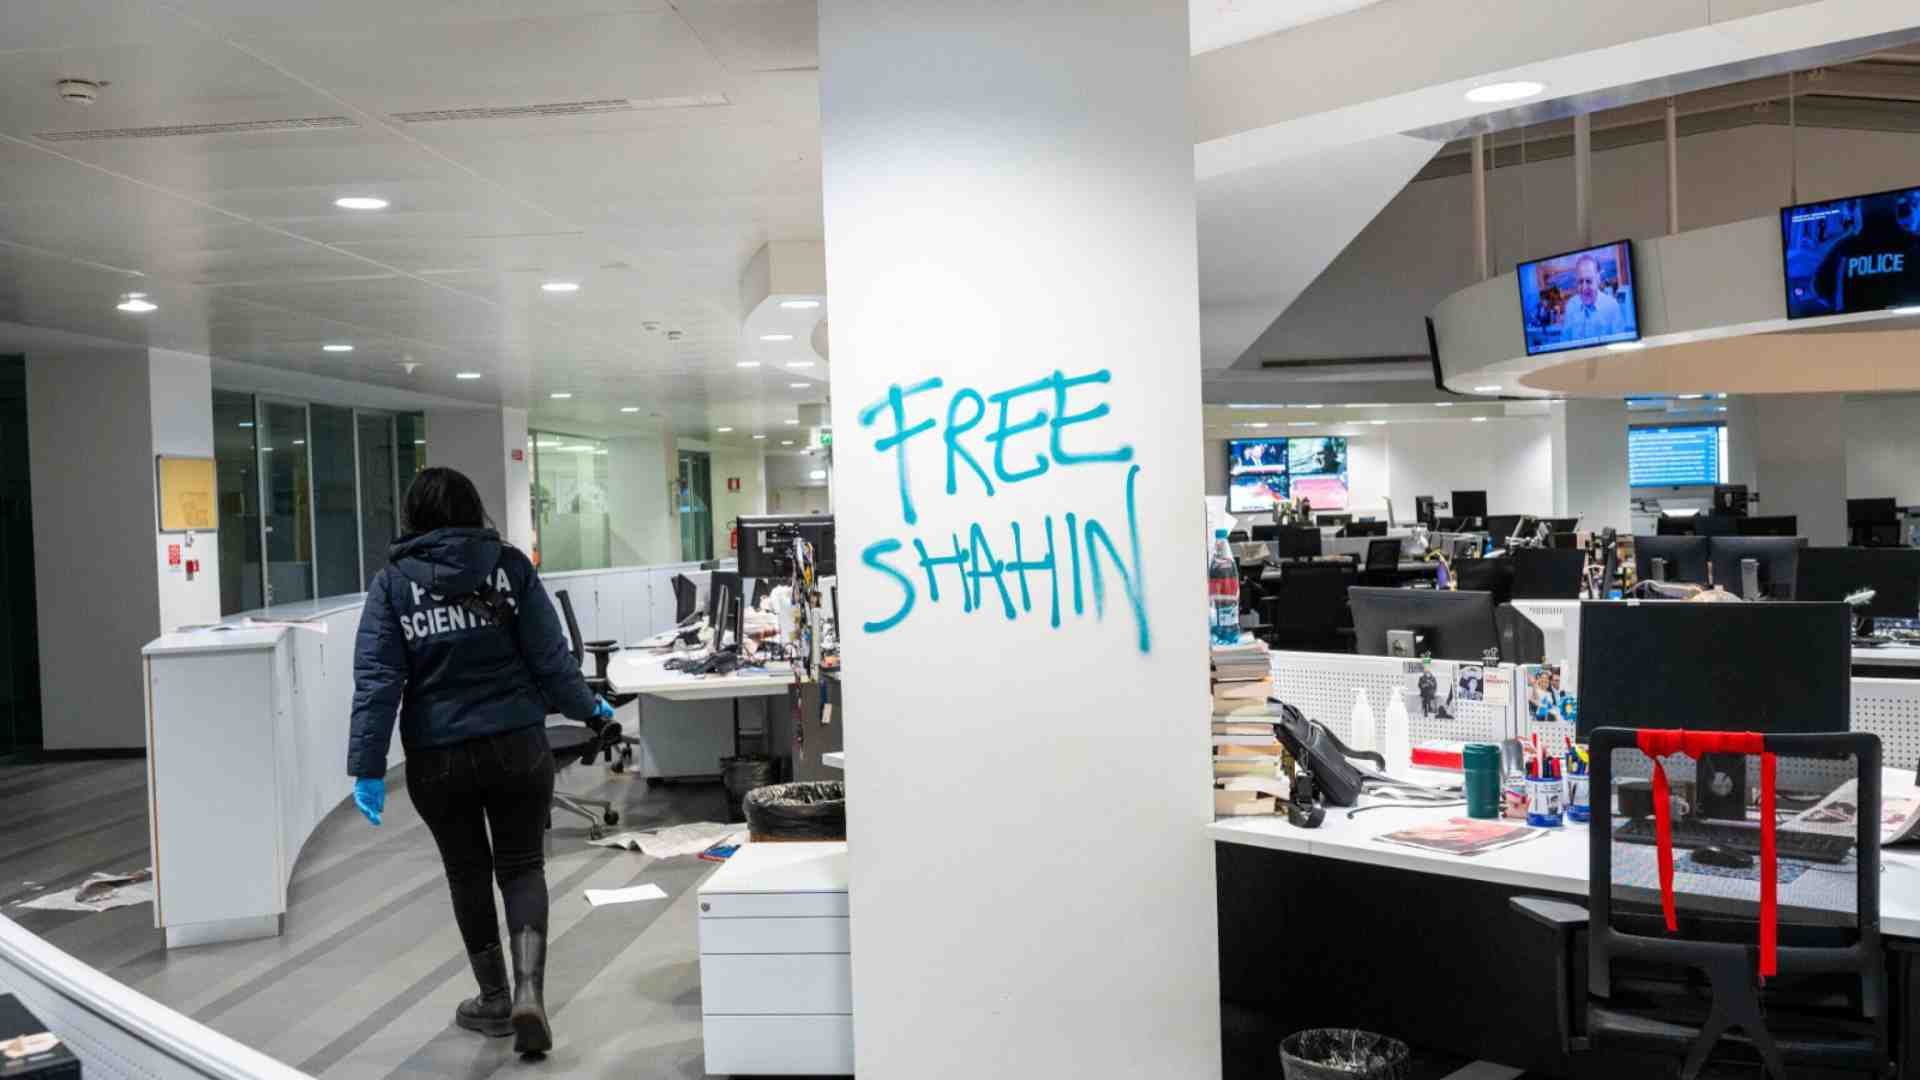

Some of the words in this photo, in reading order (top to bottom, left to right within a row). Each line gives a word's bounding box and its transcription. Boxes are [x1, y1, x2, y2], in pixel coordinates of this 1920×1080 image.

[1848, 254, 1904, 277] POLICE
[859, 369, 1134, 525] FREE
[862, 464, 1151, 654] SHAHIN
[400, 597, 519, 641] SCIENT
